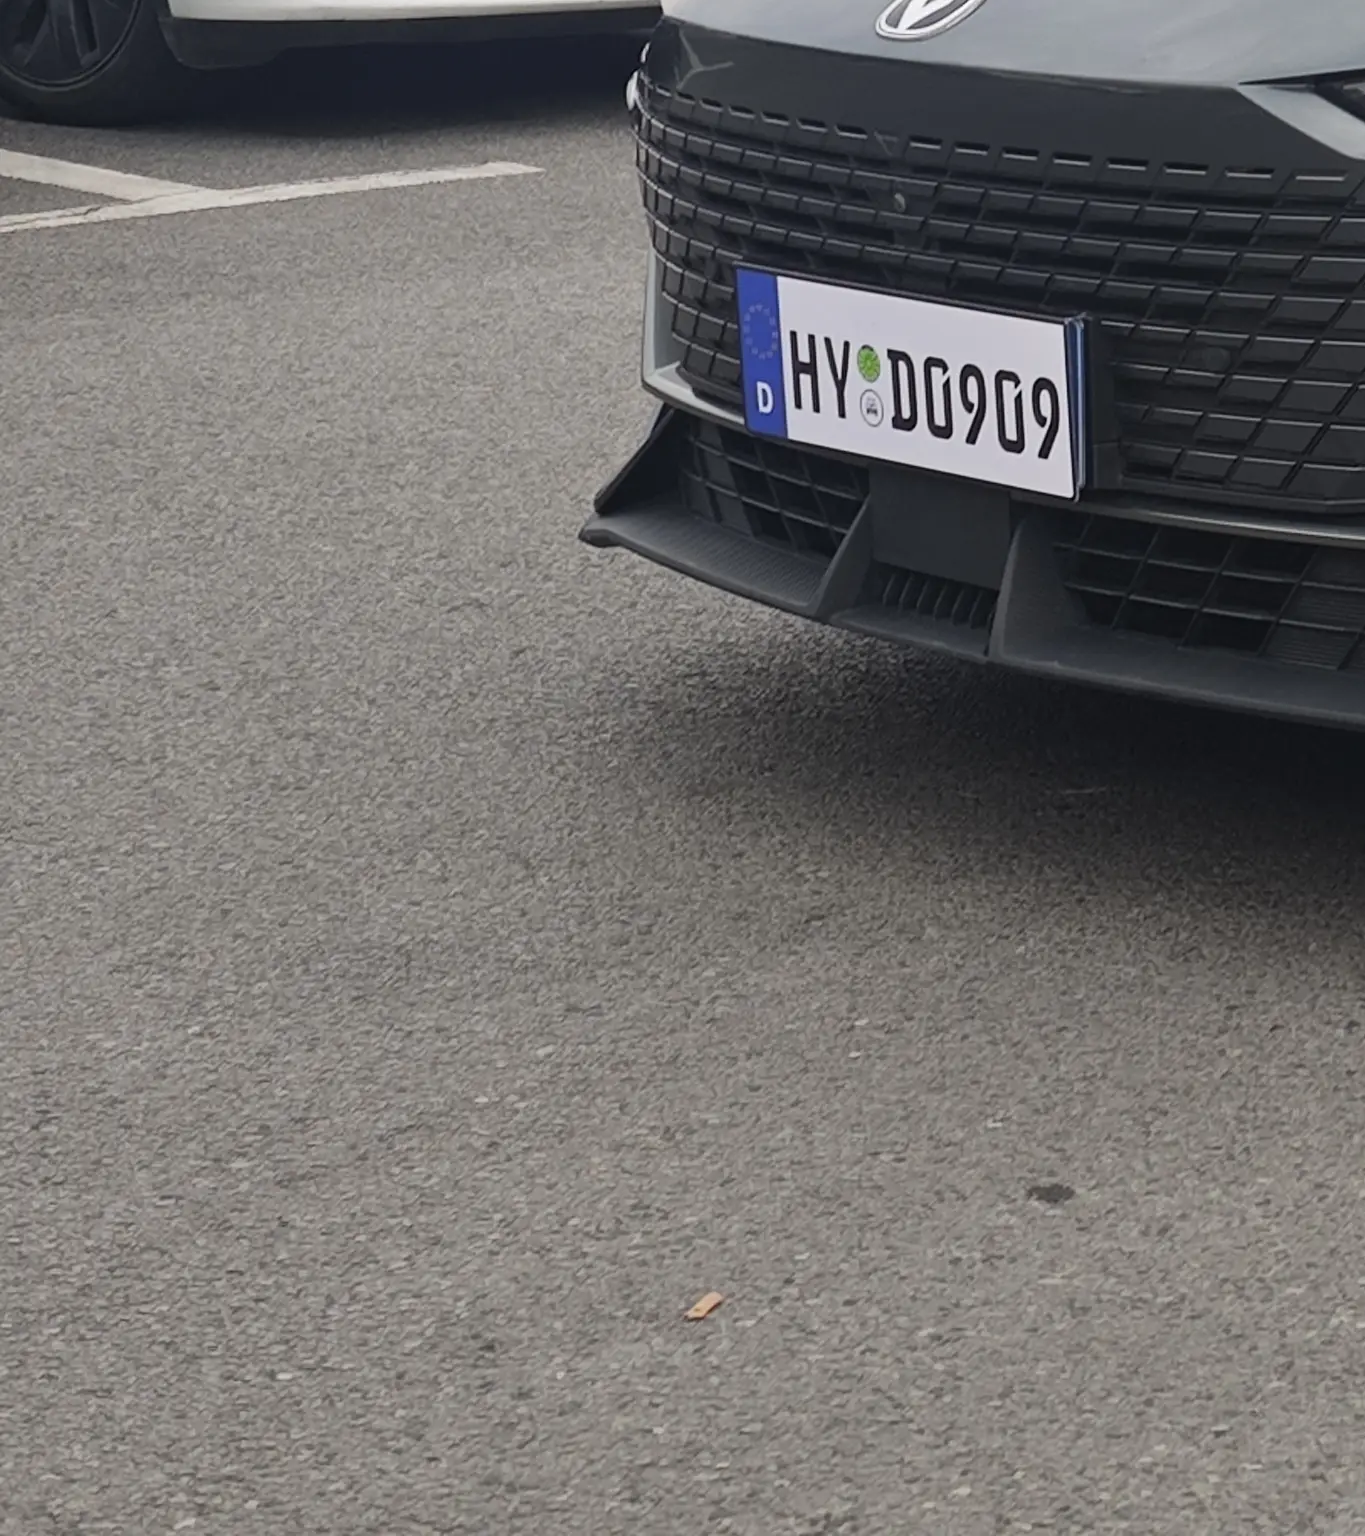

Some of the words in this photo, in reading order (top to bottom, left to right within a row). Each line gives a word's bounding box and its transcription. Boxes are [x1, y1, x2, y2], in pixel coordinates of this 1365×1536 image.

[756, 380, 775, 414] D
[789, 330, 851, 419] HY
[887, 347, 1060, 460] D0909
